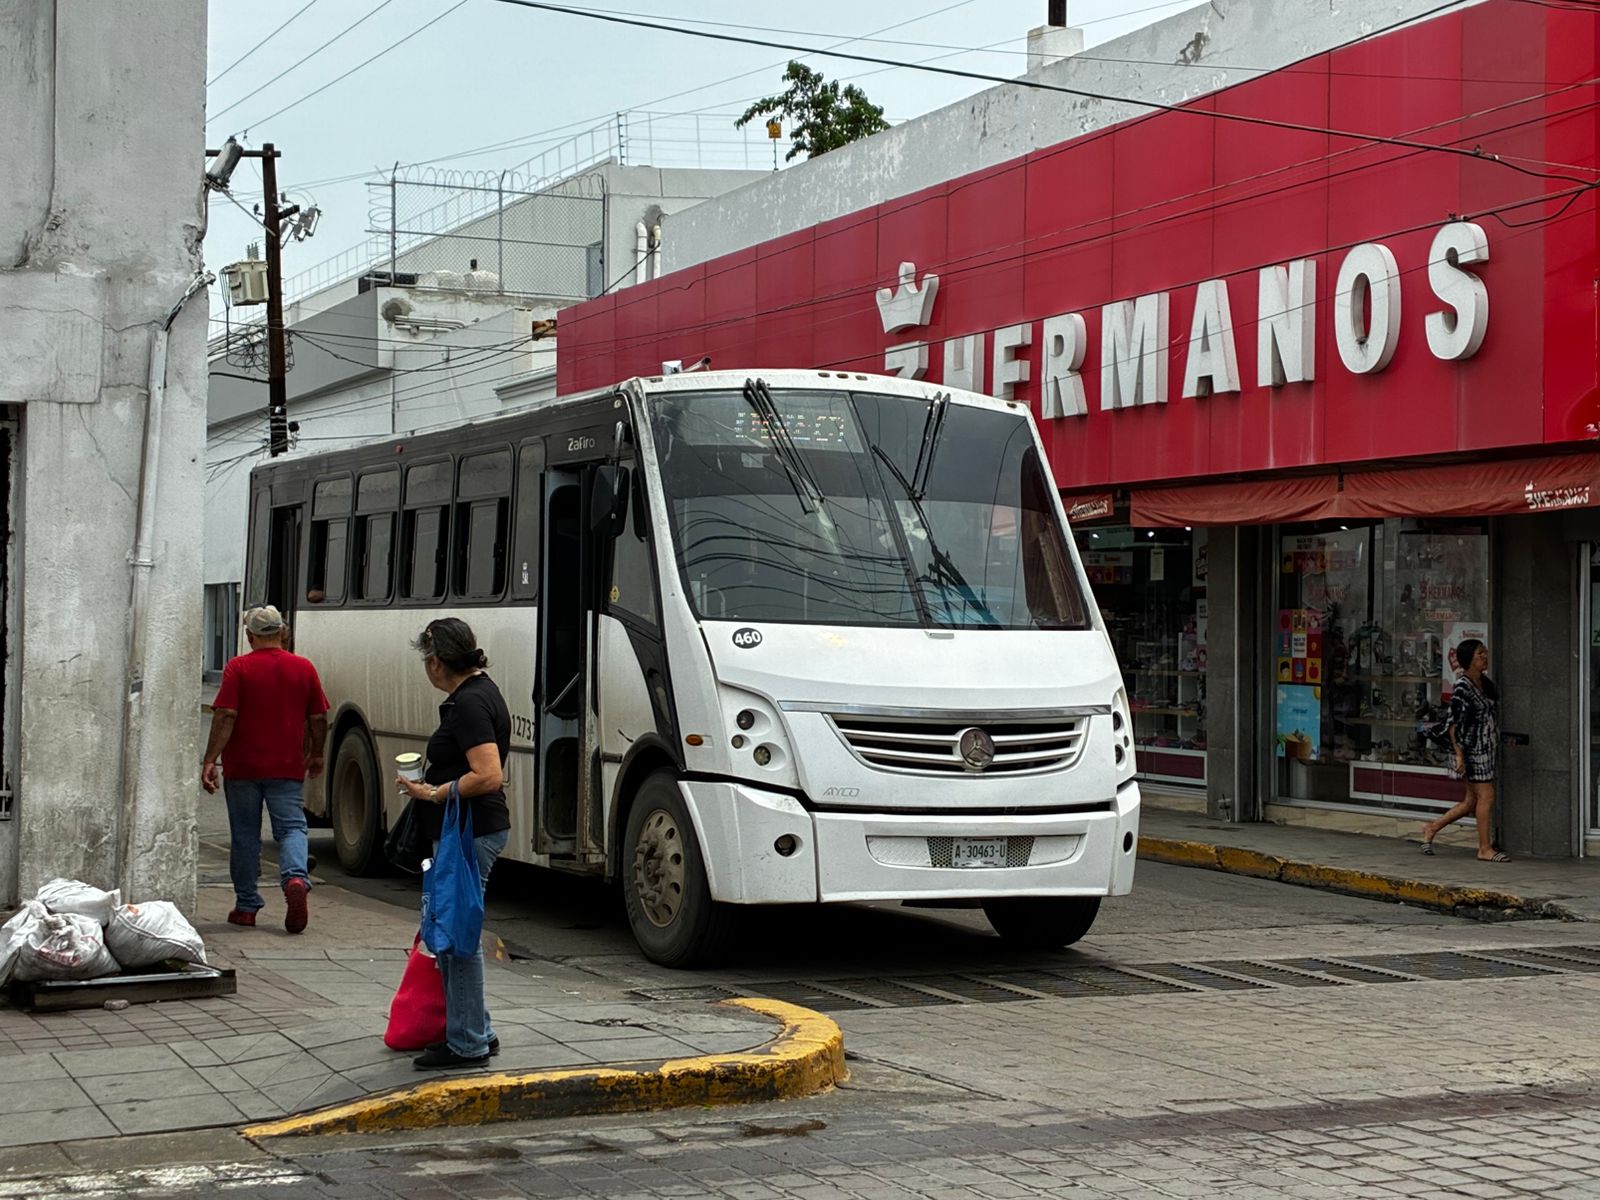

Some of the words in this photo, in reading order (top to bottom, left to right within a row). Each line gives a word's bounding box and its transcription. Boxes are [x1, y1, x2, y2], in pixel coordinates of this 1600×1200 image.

[735, 630, 761, 645] 460
[823, 786, 860, 797] AYCO
[955, 844, 1006, 858] A-30463-U
